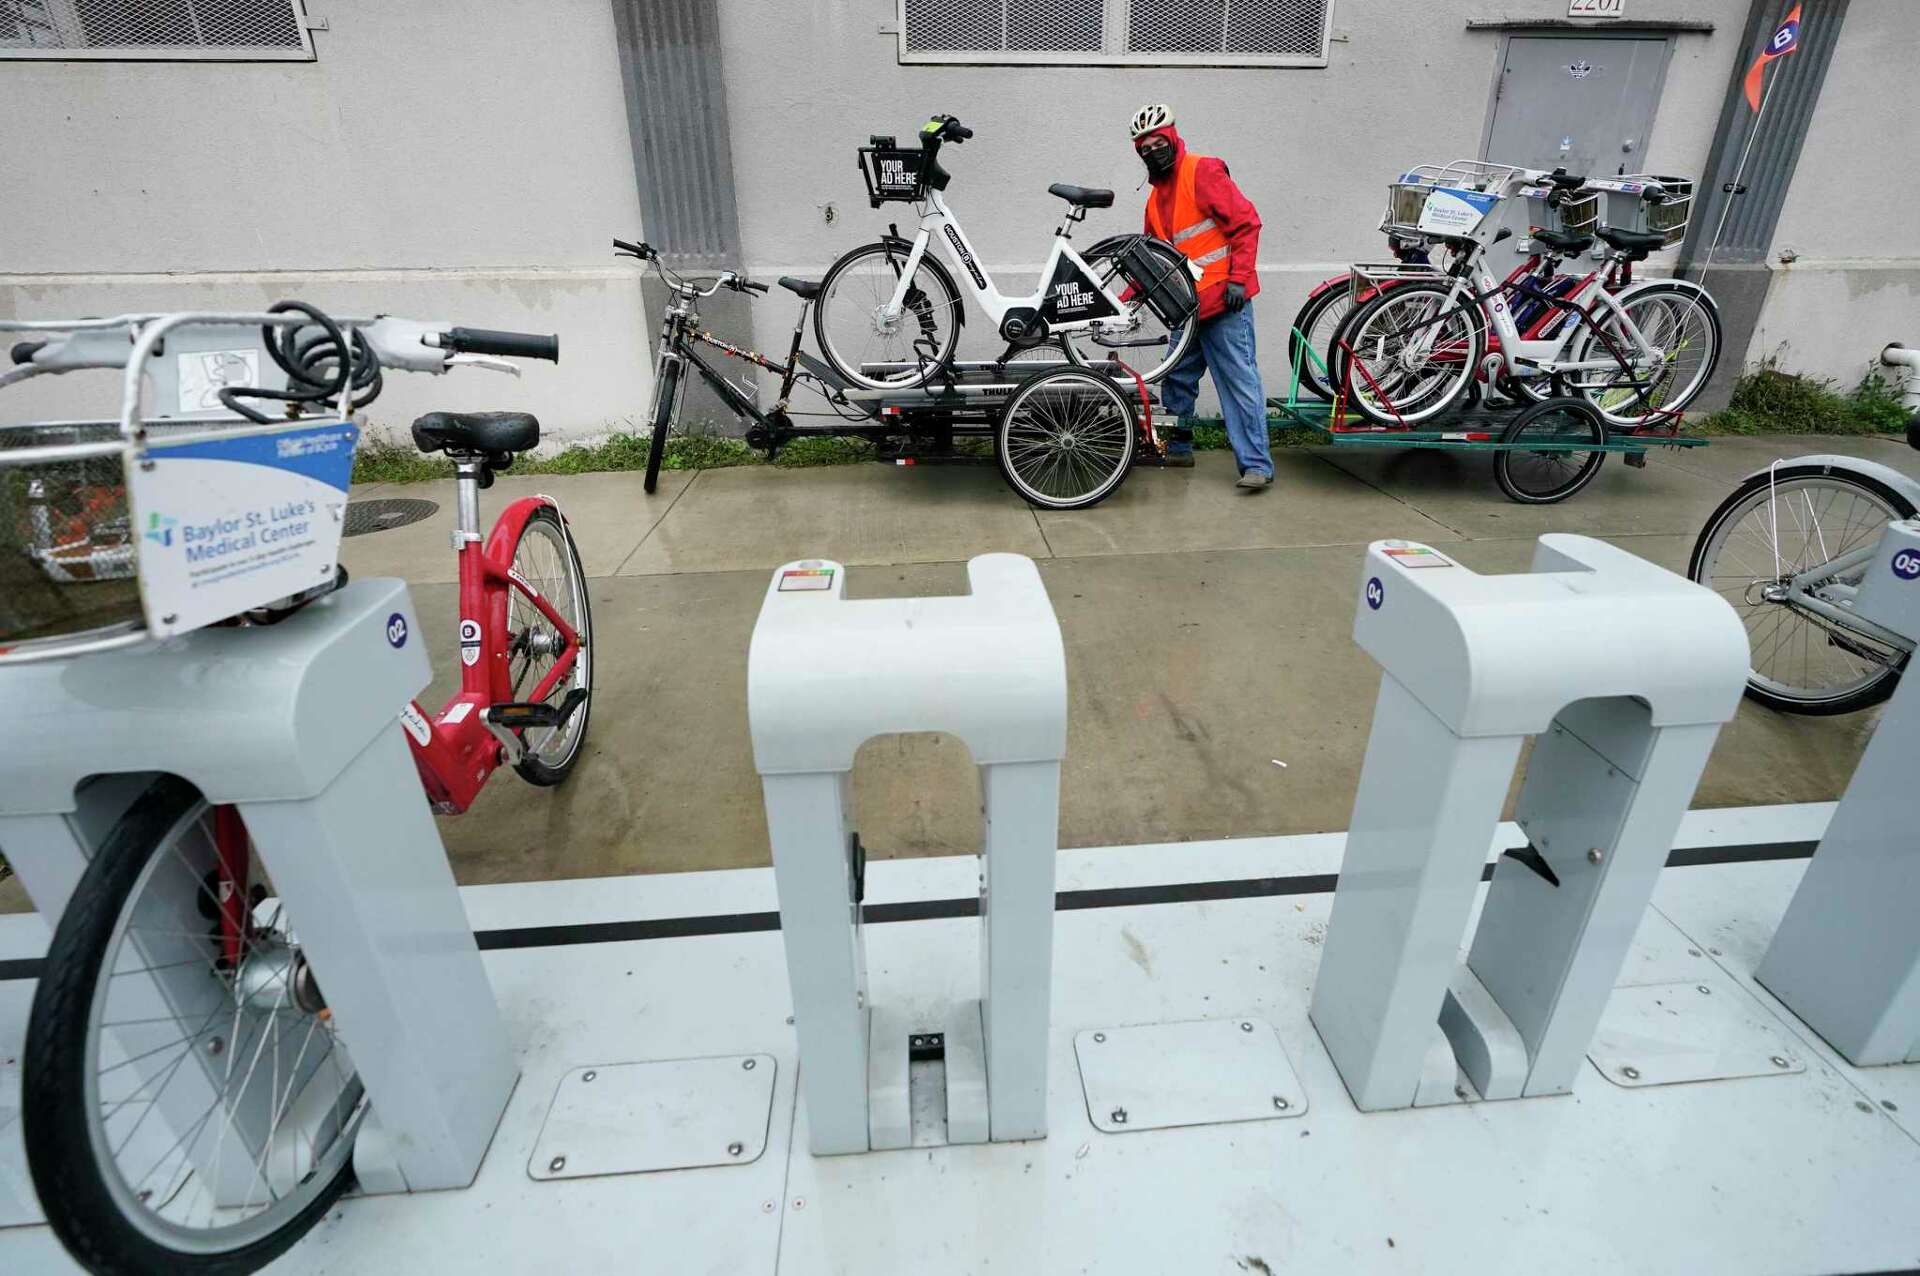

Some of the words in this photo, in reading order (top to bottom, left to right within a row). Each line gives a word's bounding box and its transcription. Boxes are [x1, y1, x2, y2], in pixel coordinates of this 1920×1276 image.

[1774, 28, 1792, 49] B
[880, 160, 903, 173] YOUR
[881, 173, 893, 185] AD
[895, 172, 917, 185] HERE
[945, 224, 965, 254] HOUSTON
[1055, 282, 1079, 296] YOUR
[1057, 296, 1069, 309] AD
[1071, 292, 1095, 307] HERE
[184, 518, 241, 542] Baylor
[246, 511, 267, 528] St.
[271, 501, 315, 521] Luke's
[186, 532, 256, 562] Medical
[260, 520, 311, 544] Center
[1894, 554, 1920, 574] 05
[1368, 582, 1382, 604] 04
[388, 619, 406, 643] 02
[464, 627, 473, 636] B
